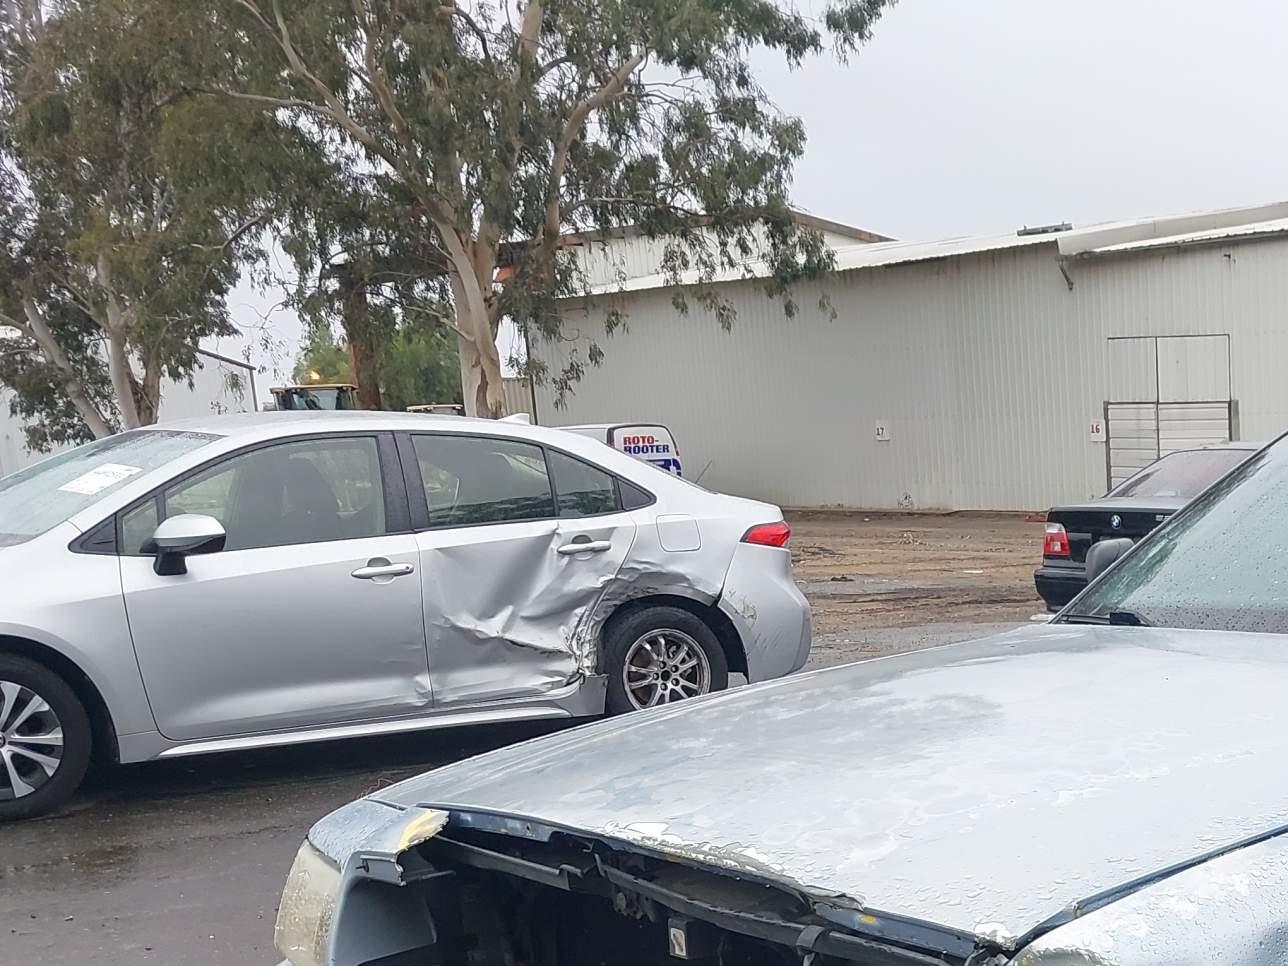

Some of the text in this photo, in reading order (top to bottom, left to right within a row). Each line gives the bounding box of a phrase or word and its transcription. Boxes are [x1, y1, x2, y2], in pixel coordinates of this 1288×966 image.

[876, 427, 885, 437] 17
[1090, 424, 1101, 434] 16
[623, 436, 660, 446] ROTO-
[623, 444, 670, 455] ROOTER
